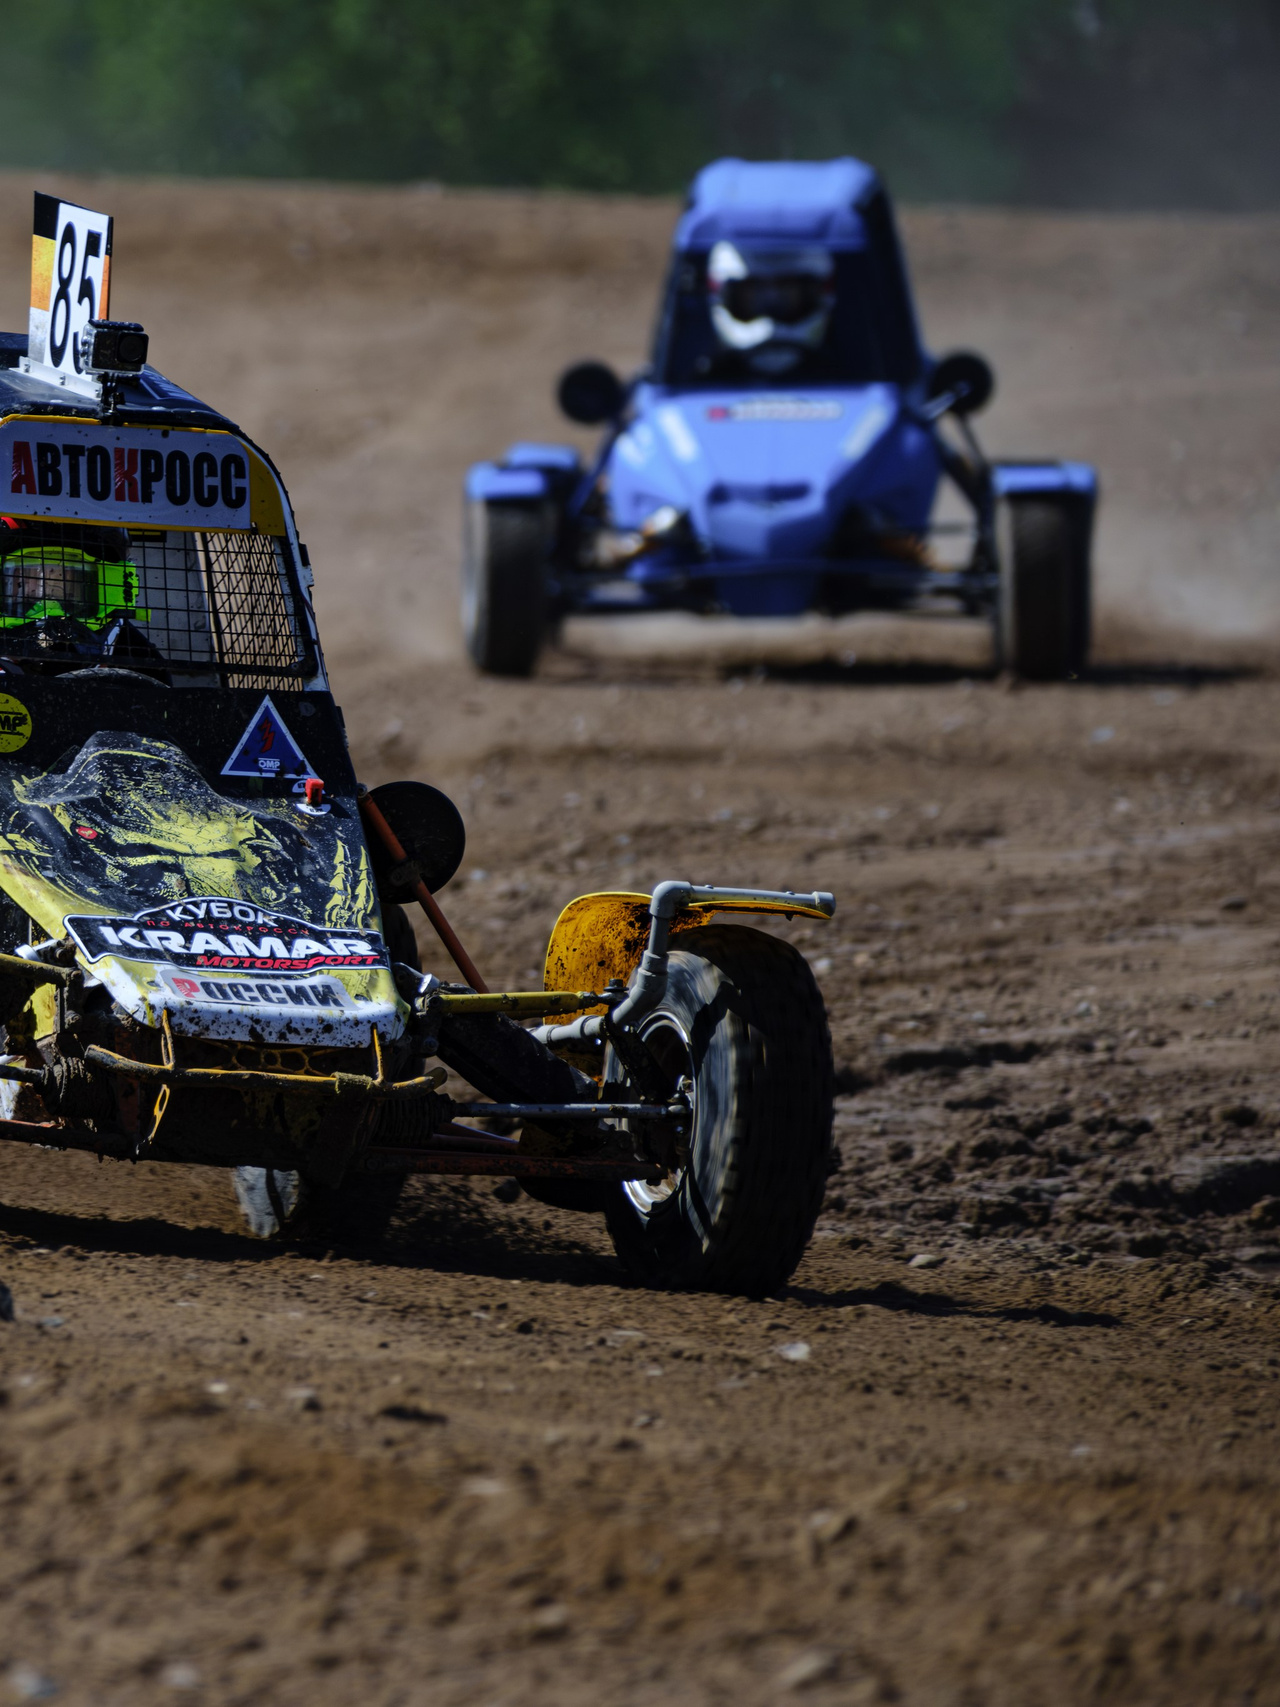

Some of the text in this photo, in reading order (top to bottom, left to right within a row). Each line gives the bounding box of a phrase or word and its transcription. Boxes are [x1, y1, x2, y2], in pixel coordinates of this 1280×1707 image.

[50, 221, 103, 375] 85
[11, 440, 247, 509] АВТОКРОСС
[258, 760, 280, 769] OMP
[166, 901, 281, 927] КУБОК
[98, 926, 379, 959] KRAMAR
[184, 922, 309, 935] АВТОКРОССУ
[196, 955, 380, 970] MOTORSPORT
[171, 977, 345, 1008] РОССИИ
